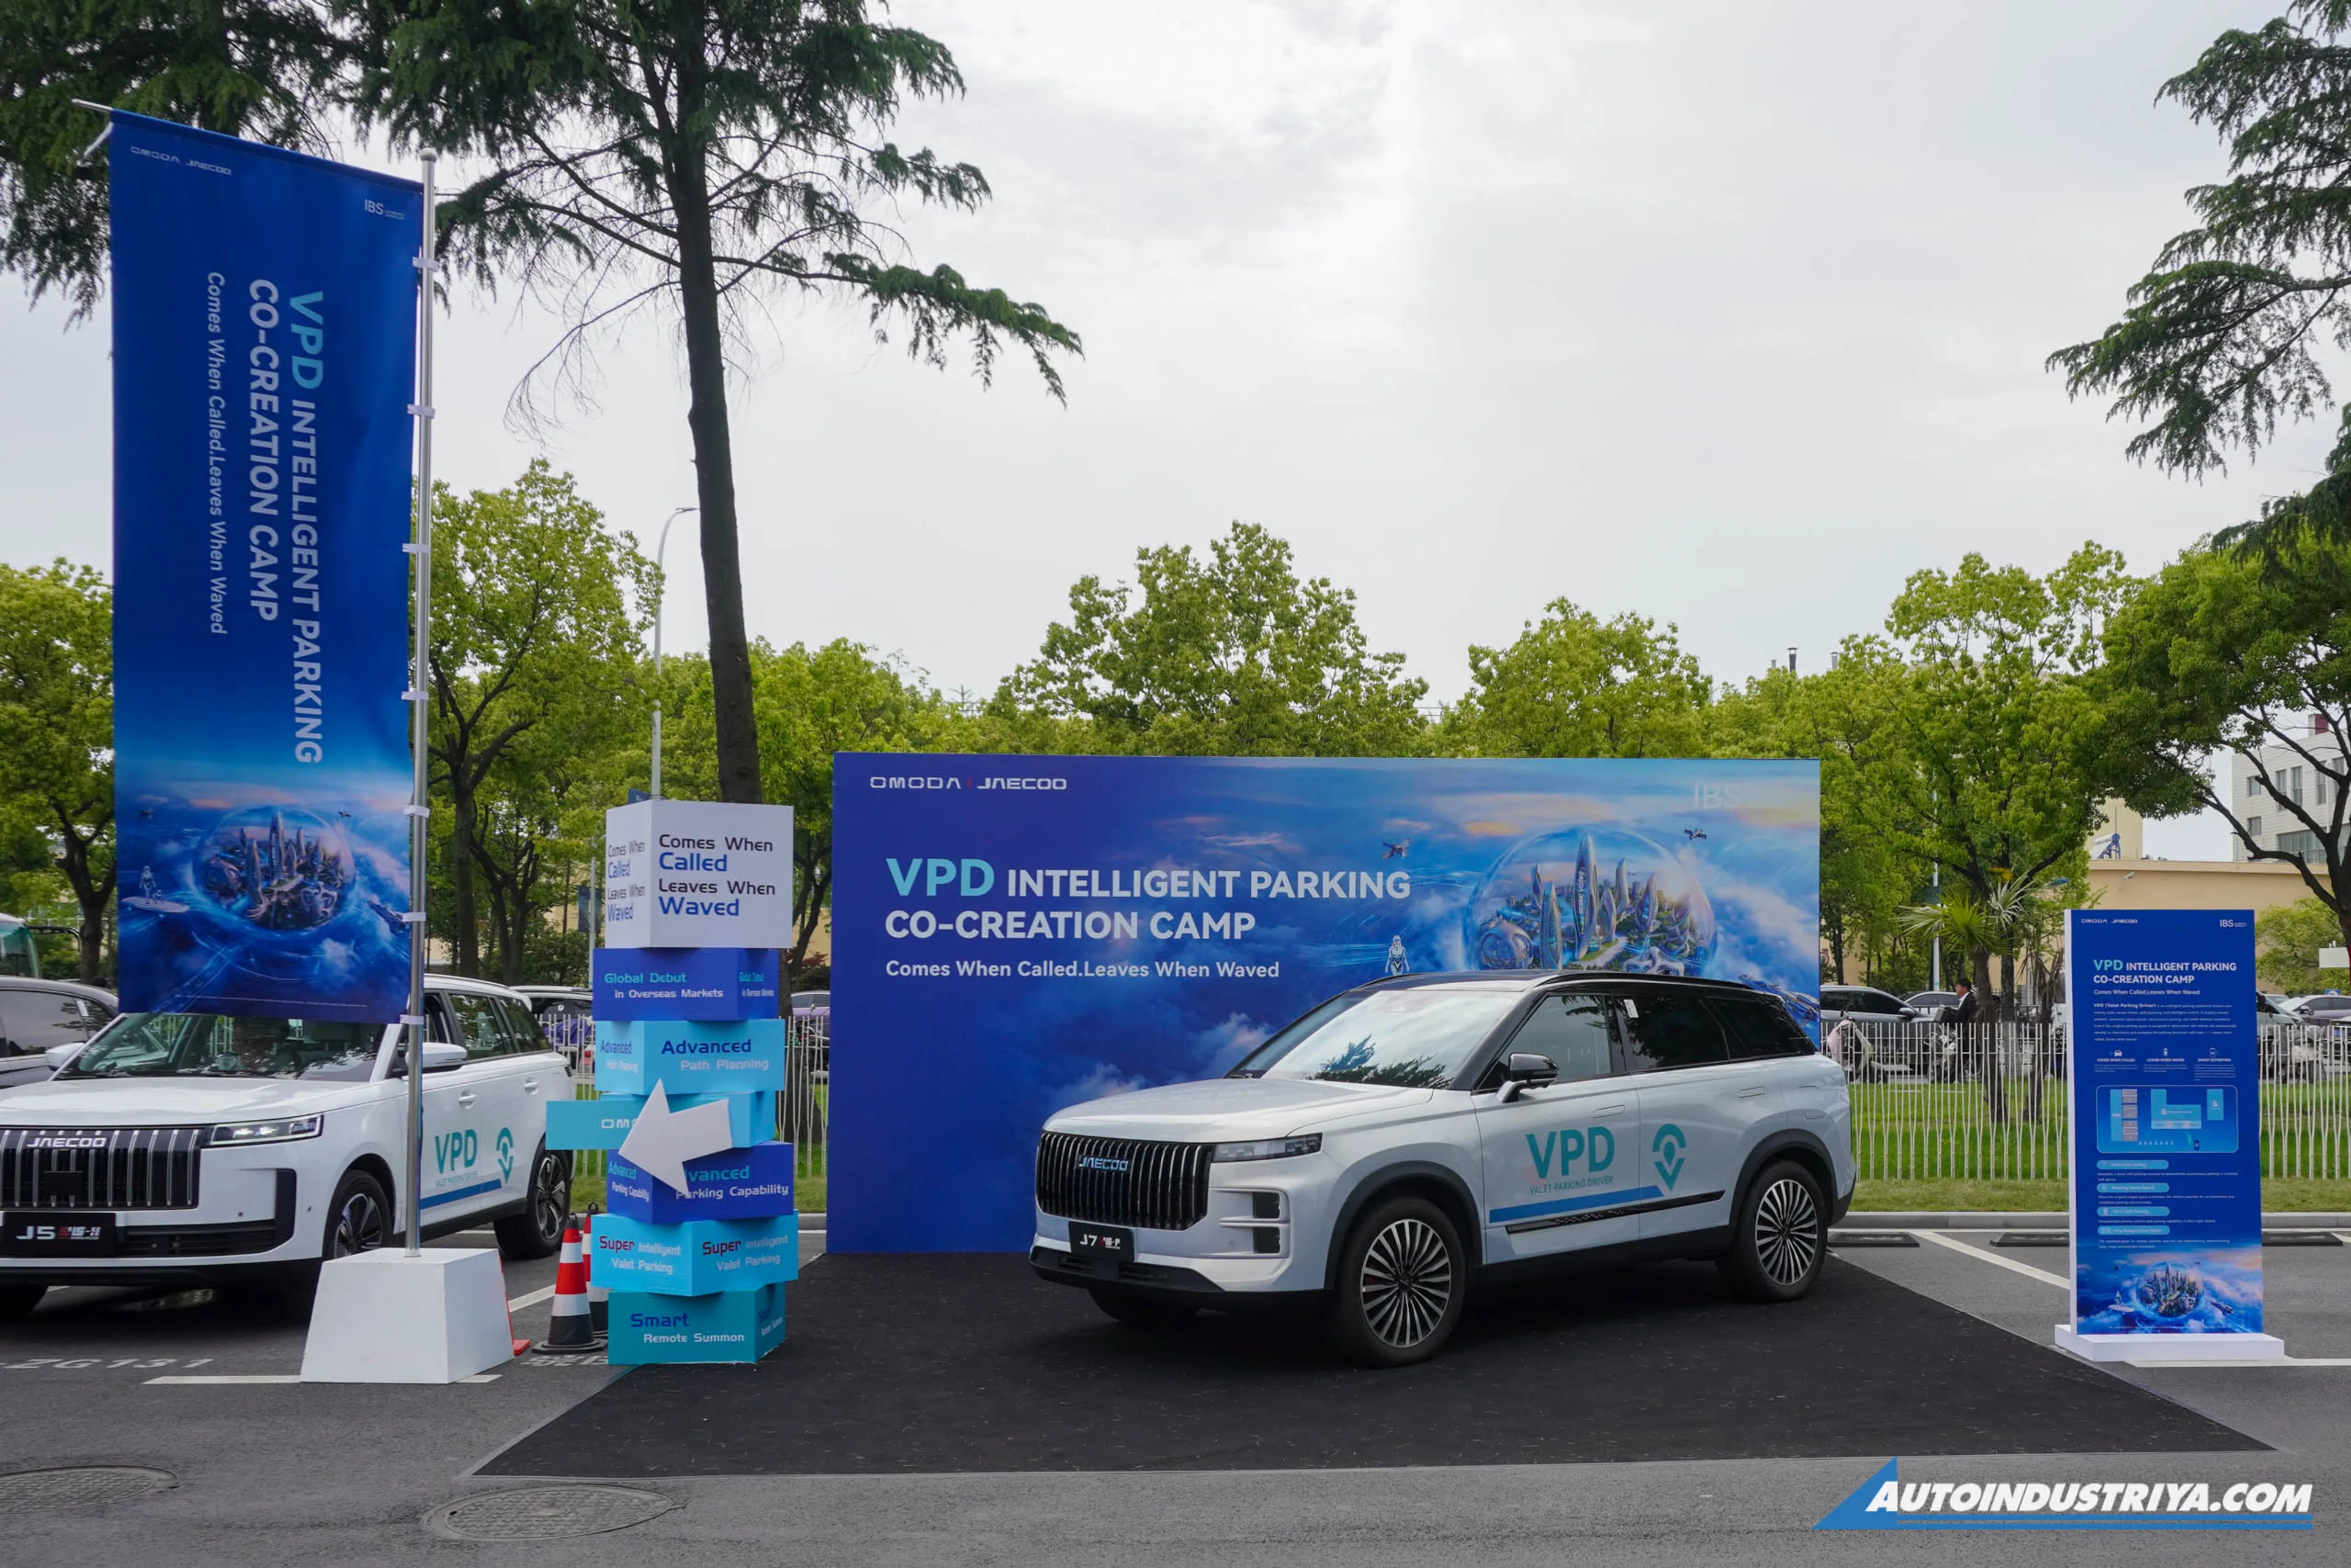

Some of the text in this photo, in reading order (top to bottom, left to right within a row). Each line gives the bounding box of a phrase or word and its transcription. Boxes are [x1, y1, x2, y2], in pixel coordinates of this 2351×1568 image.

[364, 198, 384, 215] IBS
[208, 272, 225, 333] Comes
[208, 339, 227, 390] When
[249, 279, 279, 621] CO-CREATION CAMP
[290, 291, 324, 763] VPD INTELLIGENT PARKING
[210, 521, 227, 571] When
[211, 577, 228, 634] Waved
[869, 776, 1067, 790] OMODA JAECOO
[1694, 783, 1741, 809] IBS
[608, 839, 645, 857] Comes When
[659, 834, 773, 852] Comes When
[608, 859, 630, 879] Called
[658, 852, 728, 872] Called
[659, 879, 775, 895] Leaves When
[886, 858, 1411, 899] VPD INTELLIGENT PARKING
[608, 883, 645, 900] Leaves When
[607, 901, 633, 921] Waved
[658, 896, 740, 917] Waved
[885, 910, 1256, 940] CO-CREATION CAMP
[886, 960, 950, 977] Comes
[956, 960, 1011, 977] When
[1155, 961, 1210, 978] When
[1216, 961, 1280, 978] Waved
[2093, 959, 2237, 971] VPD INTELLIGENT PARKING
[604, 973, 687, 983] Global Debut
[2093, 975, 2195, 984] CO-CREATION CAMP
[629, 989, 676, 999] Overseas
[681, 989, 723, 998] Markets
[601, 1039, 632, 1054] Advanced
[661, 1039, 752, 1055] Advanced
[681, 1059, 770, 1071] Path Planning
[27, 1138, 107, 1147] JAECOO
[434, 1128, 478, 1174] VPD
[1525, 1125, 1615, 1179] VPD
[608, 1161, 637, 1180] Advanced
[1079, 1157, 1129, 1171] JAECOO
[686, 1166, 750, 1182] vanced
[612, 1181, 628, 1196] Parking
[730, 1184, 789, 1197] Capability
[1529, 1176, 1614, 1195] VALET PARKING DRIVER
[16, 1226, 56, 1240] J5
[1080, 1234, 1098, 1247] J7
[599, 1236, 681, 1257] Super Intelligent
[702, 1235, 789, 1256] Super Intelligent
[612, 1258, 674, 1275] Valet Parking
[716, 1255, 781, 1271] Valet Parking
[630, 1313, 690, 1327] Smart
[643, 1333, 744, 1343] Remote Summon
